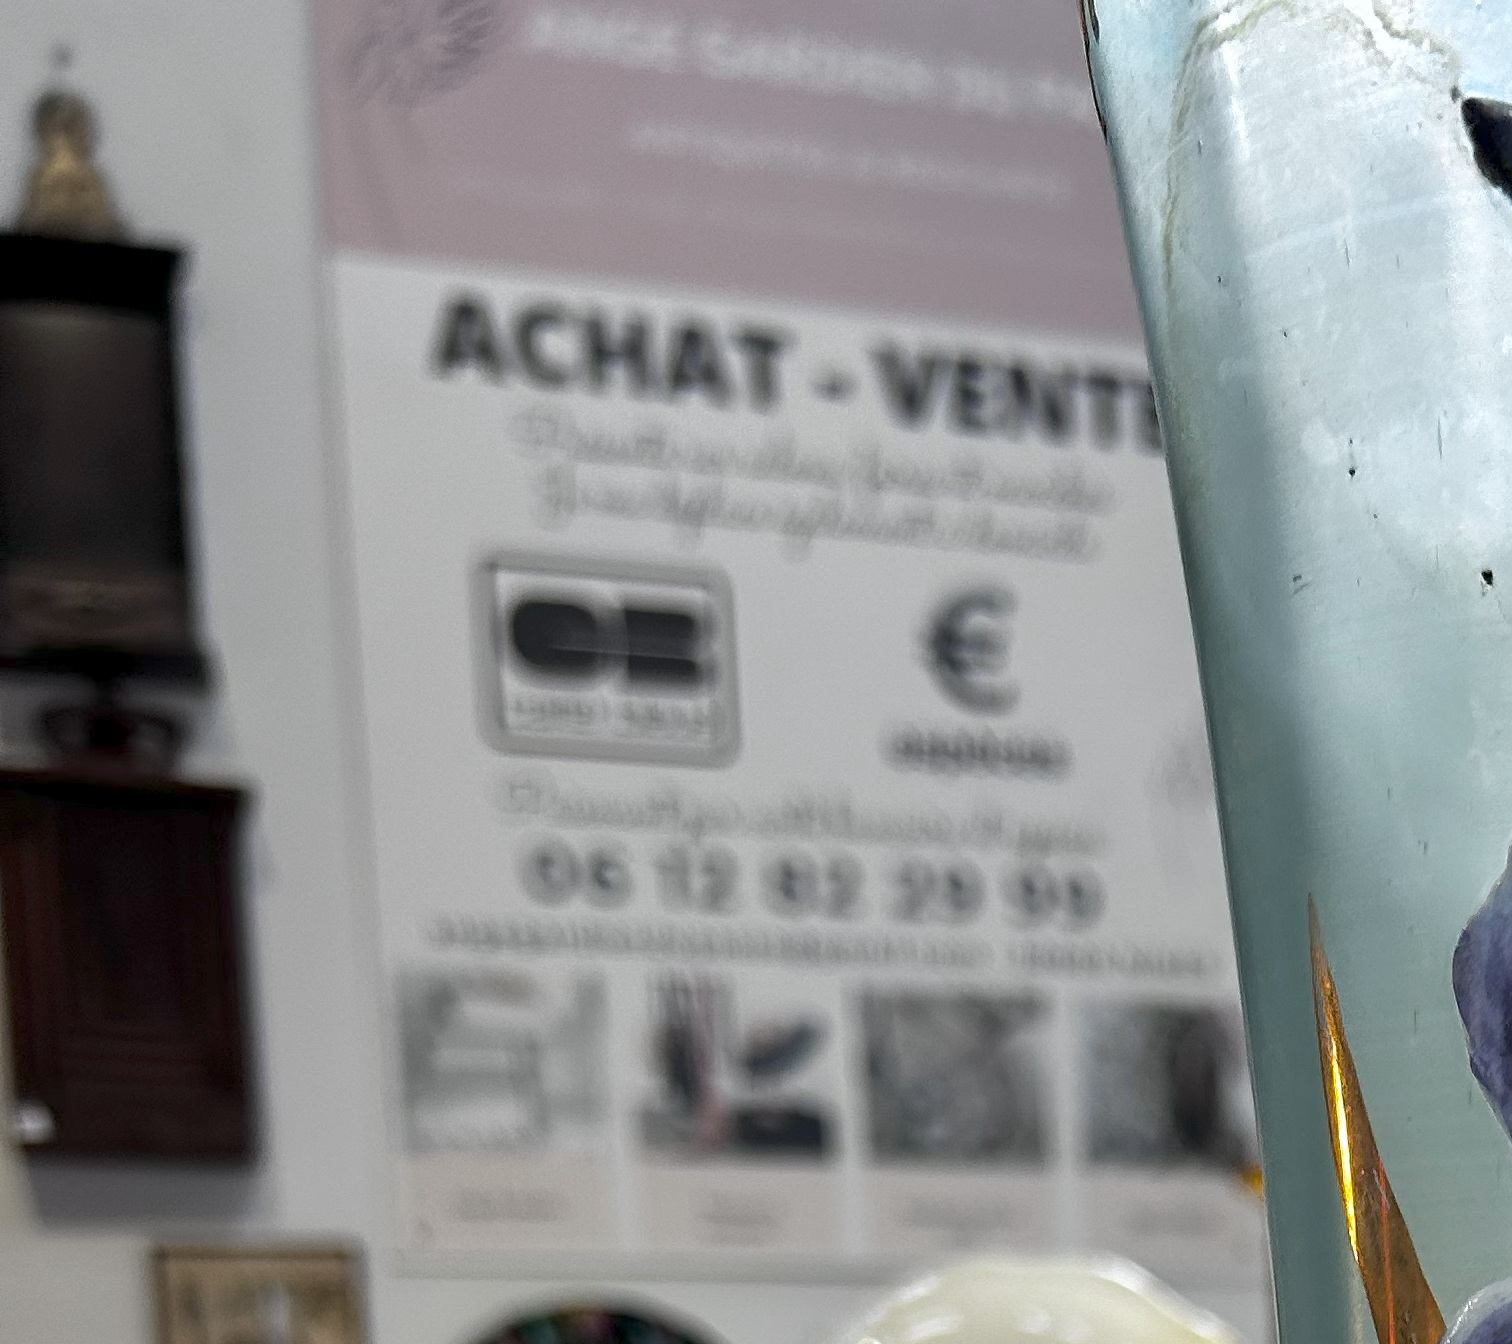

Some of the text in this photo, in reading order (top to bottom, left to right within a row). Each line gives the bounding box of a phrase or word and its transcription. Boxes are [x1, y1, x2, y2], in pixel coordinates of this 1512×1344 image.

[432, 288, 788, 411] ACHAT
[516, 838, 634, 912] 06
[653, 842, 740, 918] 12
[888, 853, 988, 928] 29
